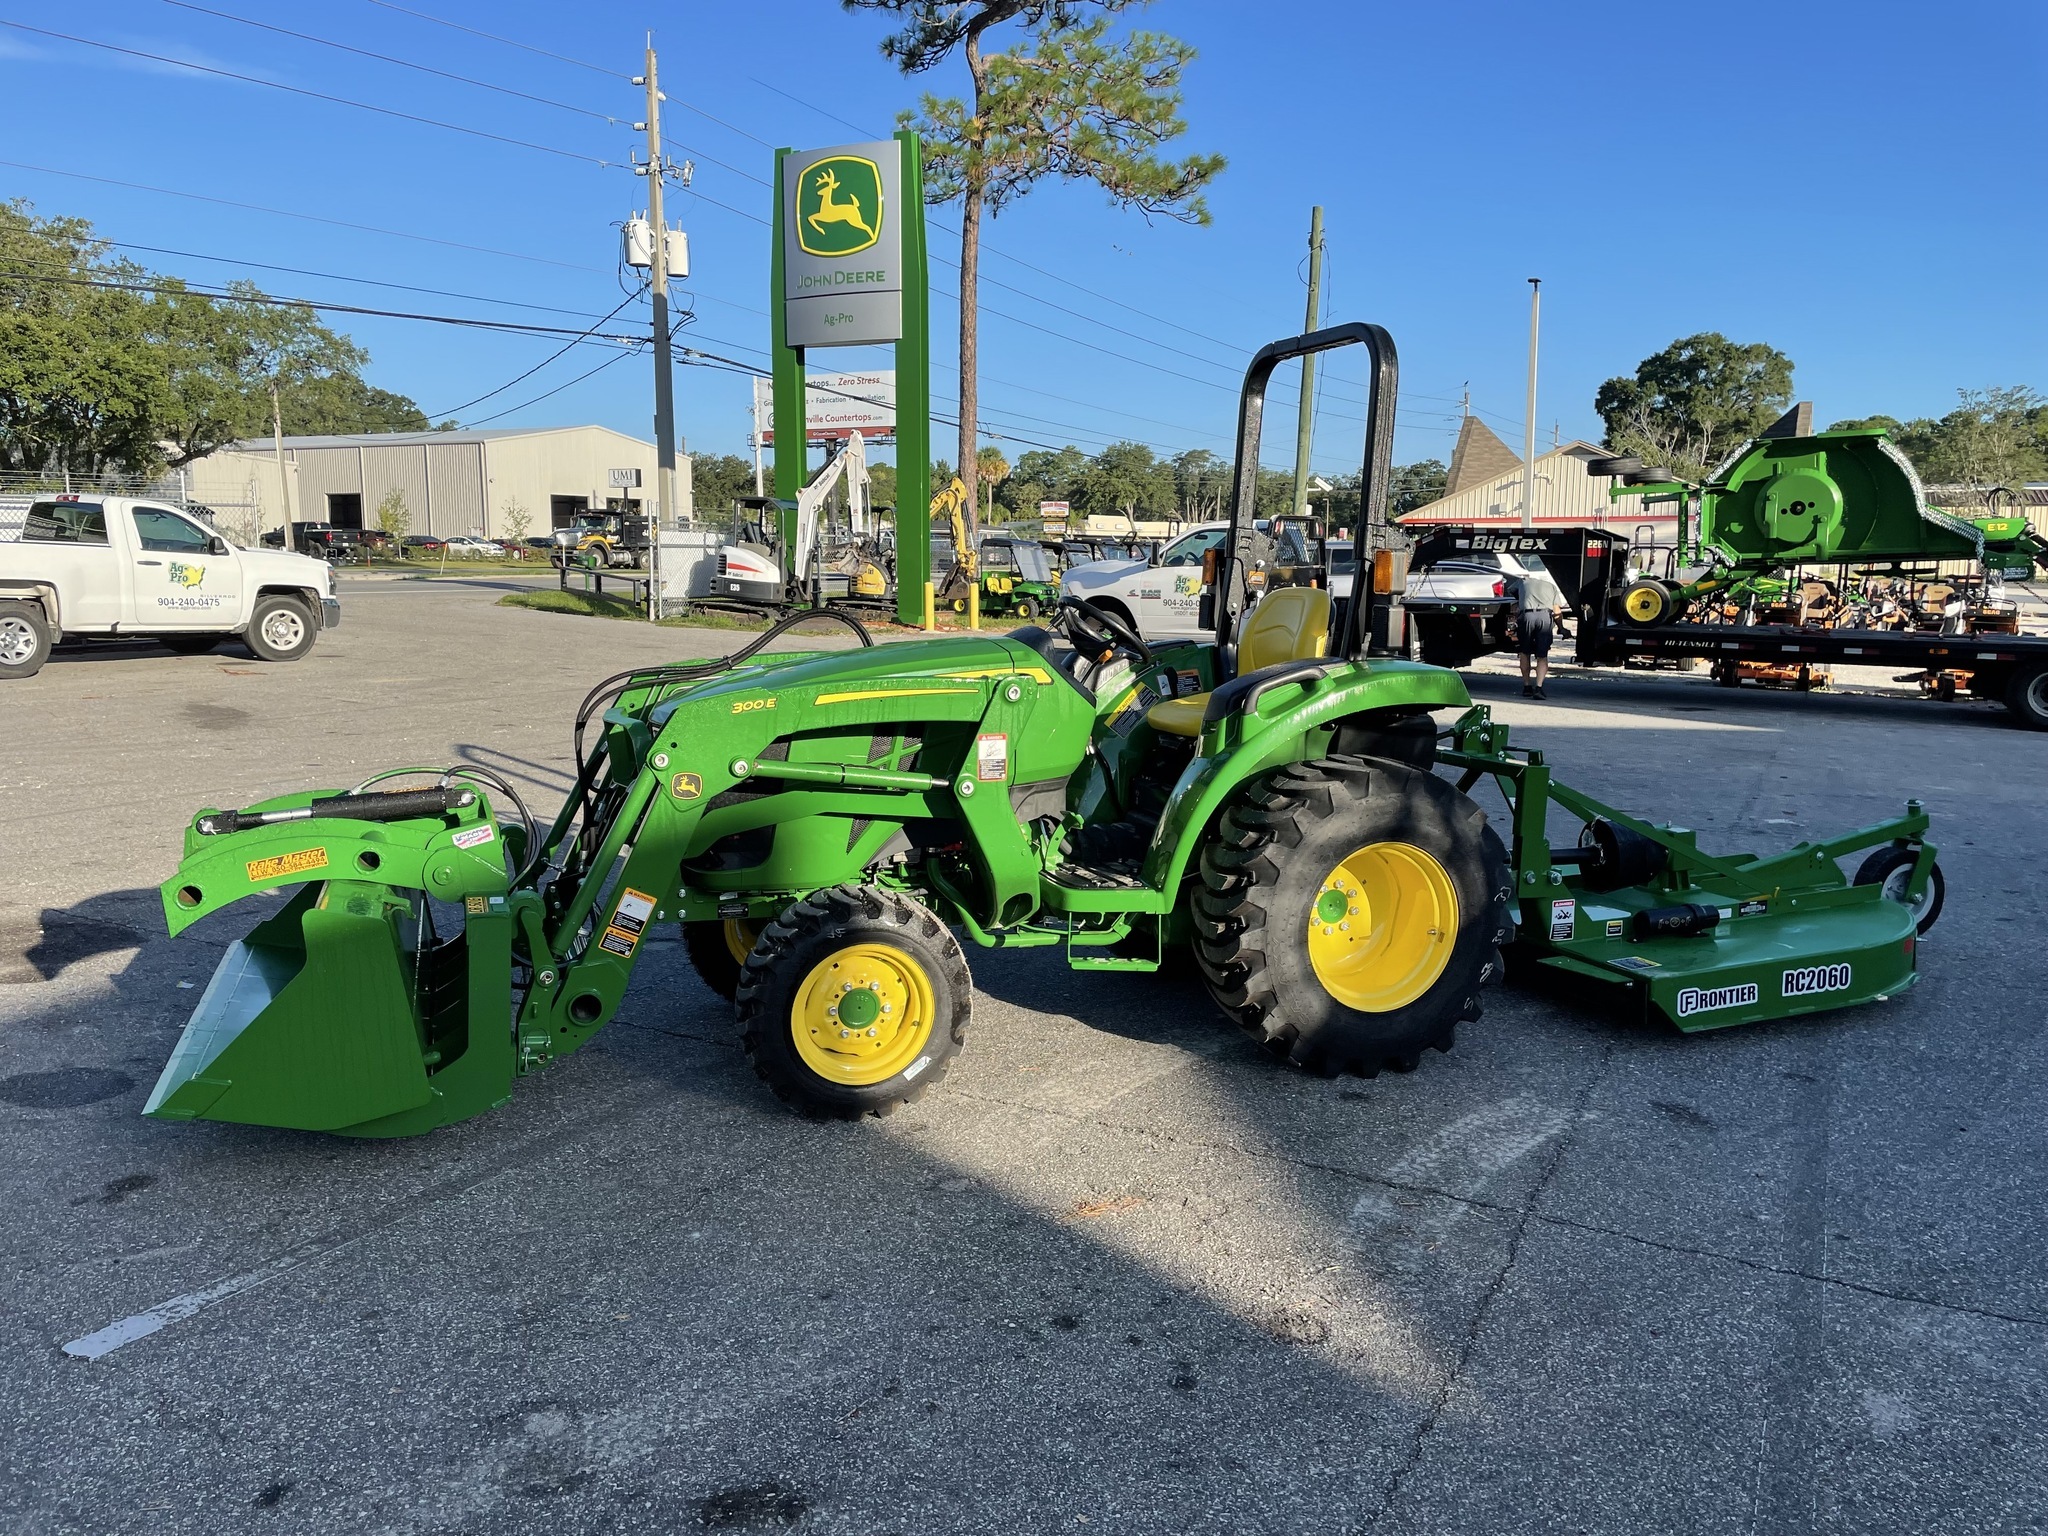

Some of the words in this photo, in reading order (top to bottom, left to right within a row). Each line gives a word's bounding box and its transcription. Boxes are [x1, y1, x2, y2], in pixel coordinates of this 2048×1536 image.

[797, 274, 831, 289] JOHN
[834, 270, 885, 285] DEERE
[824, 313, 854, 327] Ag-Pro
[838, 377, 855, 387] Zero
[857, 376, 880, 386] Stress
[816, 396, 846, 404] Fabrication
[826, 412, 871, 423] Countertops
[612, 470, 632, 480] UMI
[1471, 535, 1550, 553] BigTex
[170, 573, 188, 582] Pro
[1175, 583, 1190, 593] Pro
[157, 597, 220, 607] 904-240-0475
[1163, 599, 1200, 607] 904-240-0
[1120, 694, 1136, 711] CAUTION
[249, 859, 279, 871] Rake
[281, 849, 324, 865] Master
[1784, 964, 1850, 994] RC2060
[1680, 985, 1756, 1014] FRONTIER
